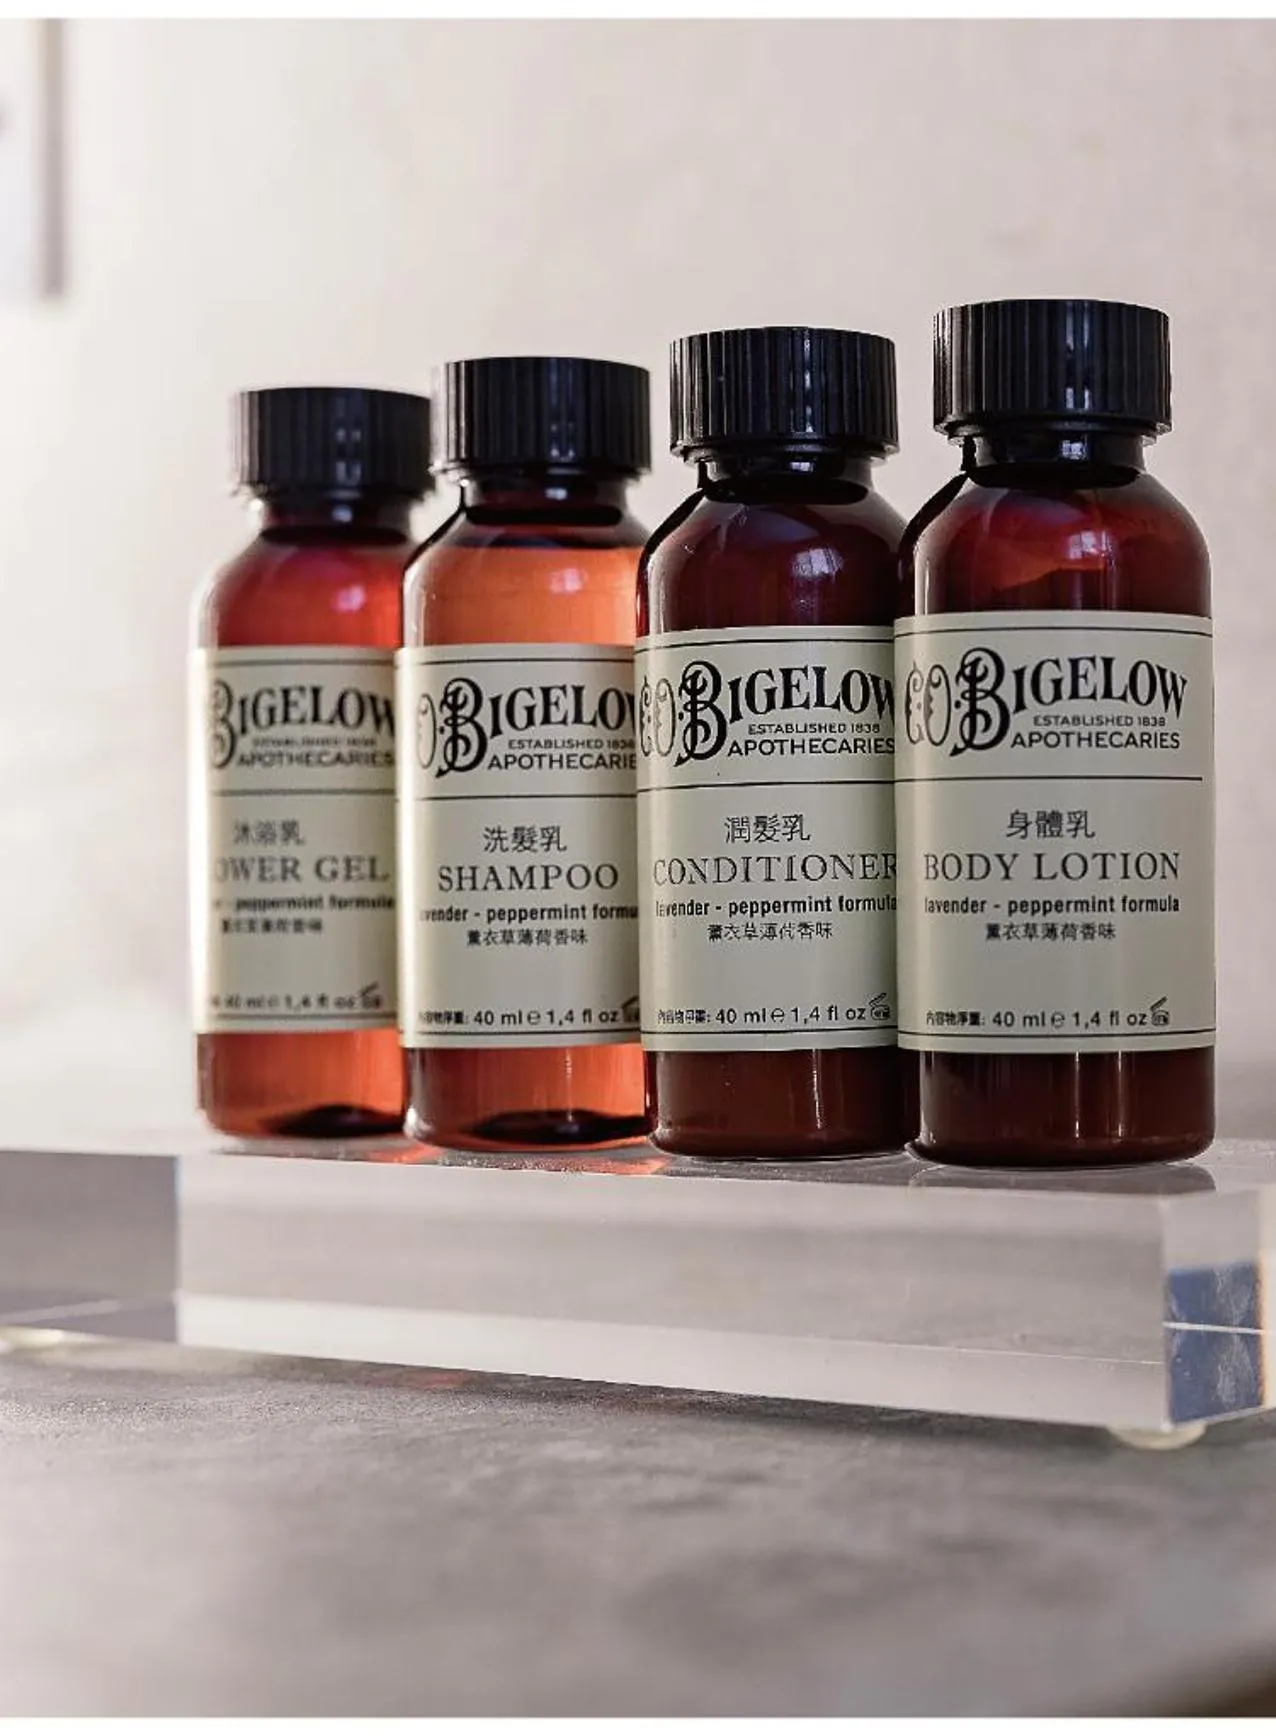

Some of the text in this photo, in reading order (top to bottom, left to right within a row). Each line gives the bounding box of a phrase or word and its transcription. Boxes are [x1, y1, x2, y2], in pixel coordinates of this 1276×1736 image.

[950, 647, 1189, 757] BIGELOW
[435, 677, 636, 778] BIGELO
[748, 722, 881, 735] ESTABLISHED 1838
[1033, 715, 1166, 728] ESTABLISHED 1838
[508, 738, 604, 750] ESTABLISHED
[727, 737, 895, 757] APOTHECARIES
[1010, 731, 1181, 749] APOTHECARIES
[487, 753, 637, 771] APOTHECARIE
[724, 813, 811, 844] 潤髮乳
[1006, 809, 1097, 840] 身體乳
[483, 825, 568, 853] 洗髮乳
[216, 855, 391, 883] OWER GEL
[437, 863, 619, 892] SHAMPOO
[653, 852, 897, 886] CONDITIONER
[924, 852, 1182, 881] BODY LOTION
[420, 905, 469, 922] vender
[487, 904, 587, 924] peppermint
[592, 903, 638, 920] formu
[655, 899, 711, 918] lavender
[728, 896, 836, 918] peppermint
[924, 895, 987, 914] lavender
[1007, 895, 1116, 917] peppermint
[1121, 894, 1181, 913] formula
[473, 1010, 495, 1026] 40
[500, 1009, 523, 1026] ml
[546, 1009, 575, 1027] 1,4
[598, 1011, 619, 1023] oz
[715, 1008, 738, 1025] 40
[743, 1007, 767, 1024] ml
[790, 1006, 821, 1025] 1,4
[826, 1004, 839, 1021] fl
[845, 1008, 866, 1021] oz
[992, 1011, 1015, 1028] 40
[1022, 1010, 1046, 1028] ml
[1073, 1010, 1101, 1029] 1,4
[1108, 1009, 1120, 1027] fl
[1126, 1013, 1148, 1027] oz
